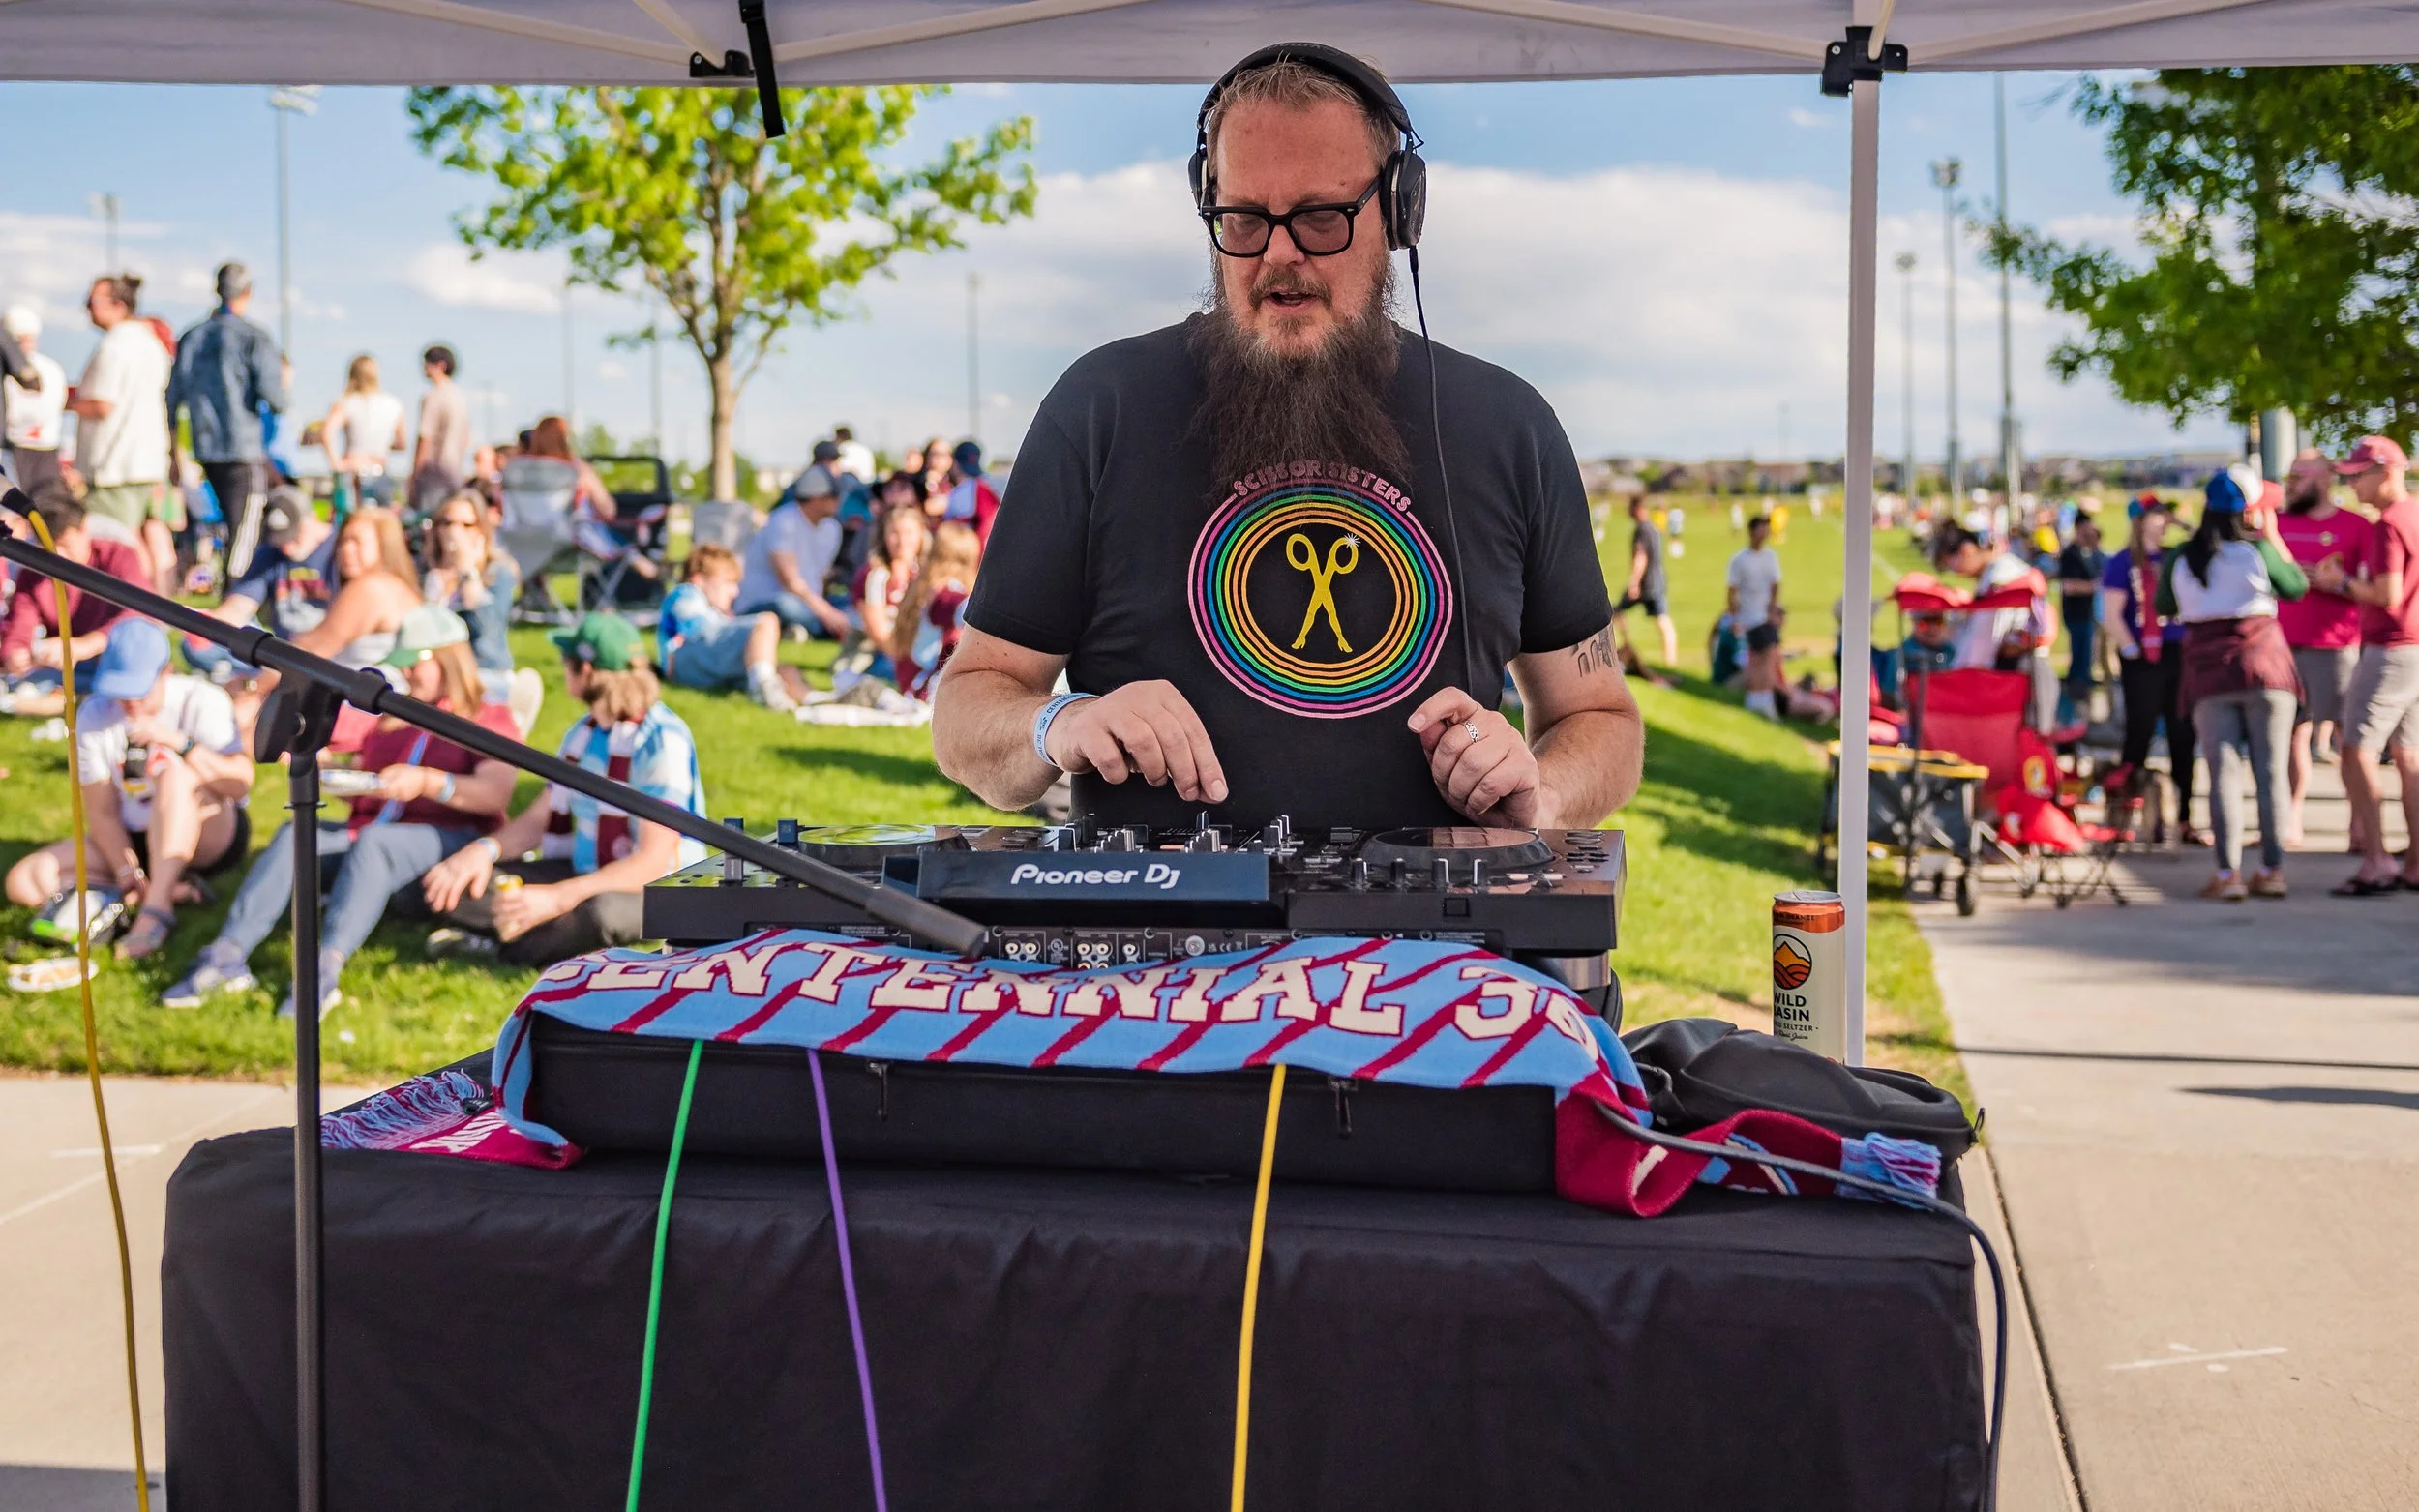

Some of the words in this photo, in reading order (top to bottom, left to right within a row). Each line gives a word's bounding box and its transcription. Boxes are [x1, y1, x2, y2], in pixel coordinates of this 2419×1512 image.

[1233, 460, 1322, 496] SCISSOR
[1329, 462, 1412, 512] SISTERS
[1010, 863, 1139, 884] Pioneer
[1774, 1006, 1809, 1022] ASIN
[1783, 1023, 1813, 1031] SELTZER
